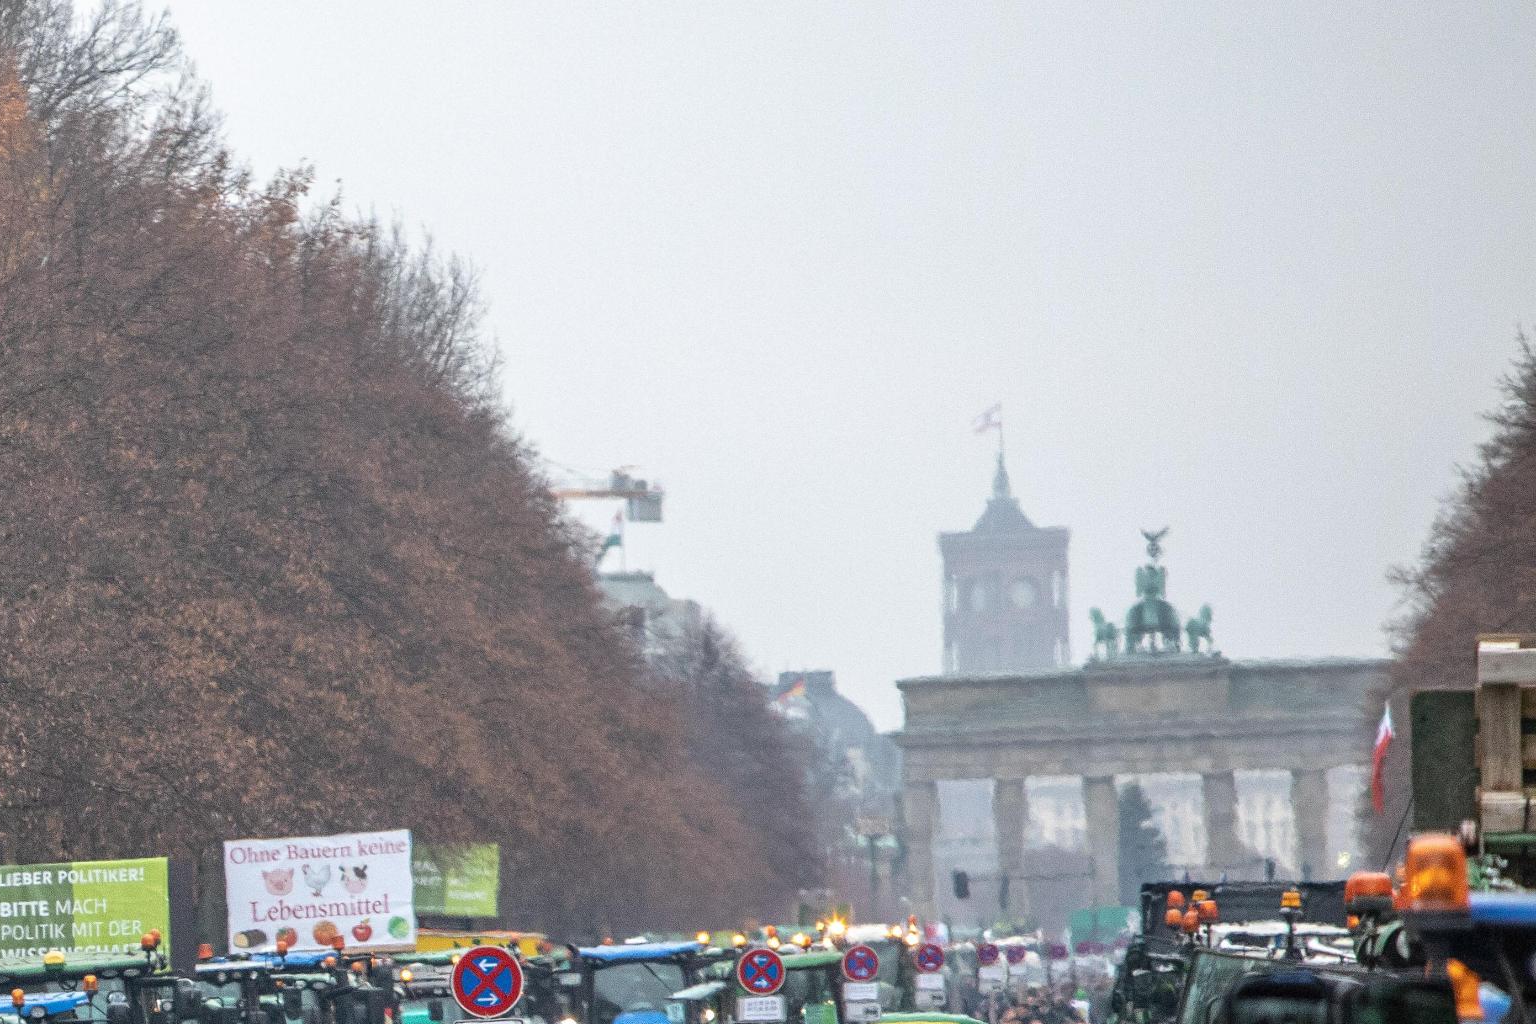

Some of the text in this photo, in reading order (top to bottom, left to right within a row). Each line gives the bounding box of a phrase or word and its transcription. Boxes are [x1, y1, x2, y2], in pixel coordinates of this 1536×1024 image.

[229, 838, 407, 865] Ohne Bauern keine
[57, 867, 145, 885] POLITIKER!
[55, 898, 107, 915] MACH
[249, 893, 391, 923] Lebensmittel
[0, 919, 143, 941] POLITIK MIT DER
